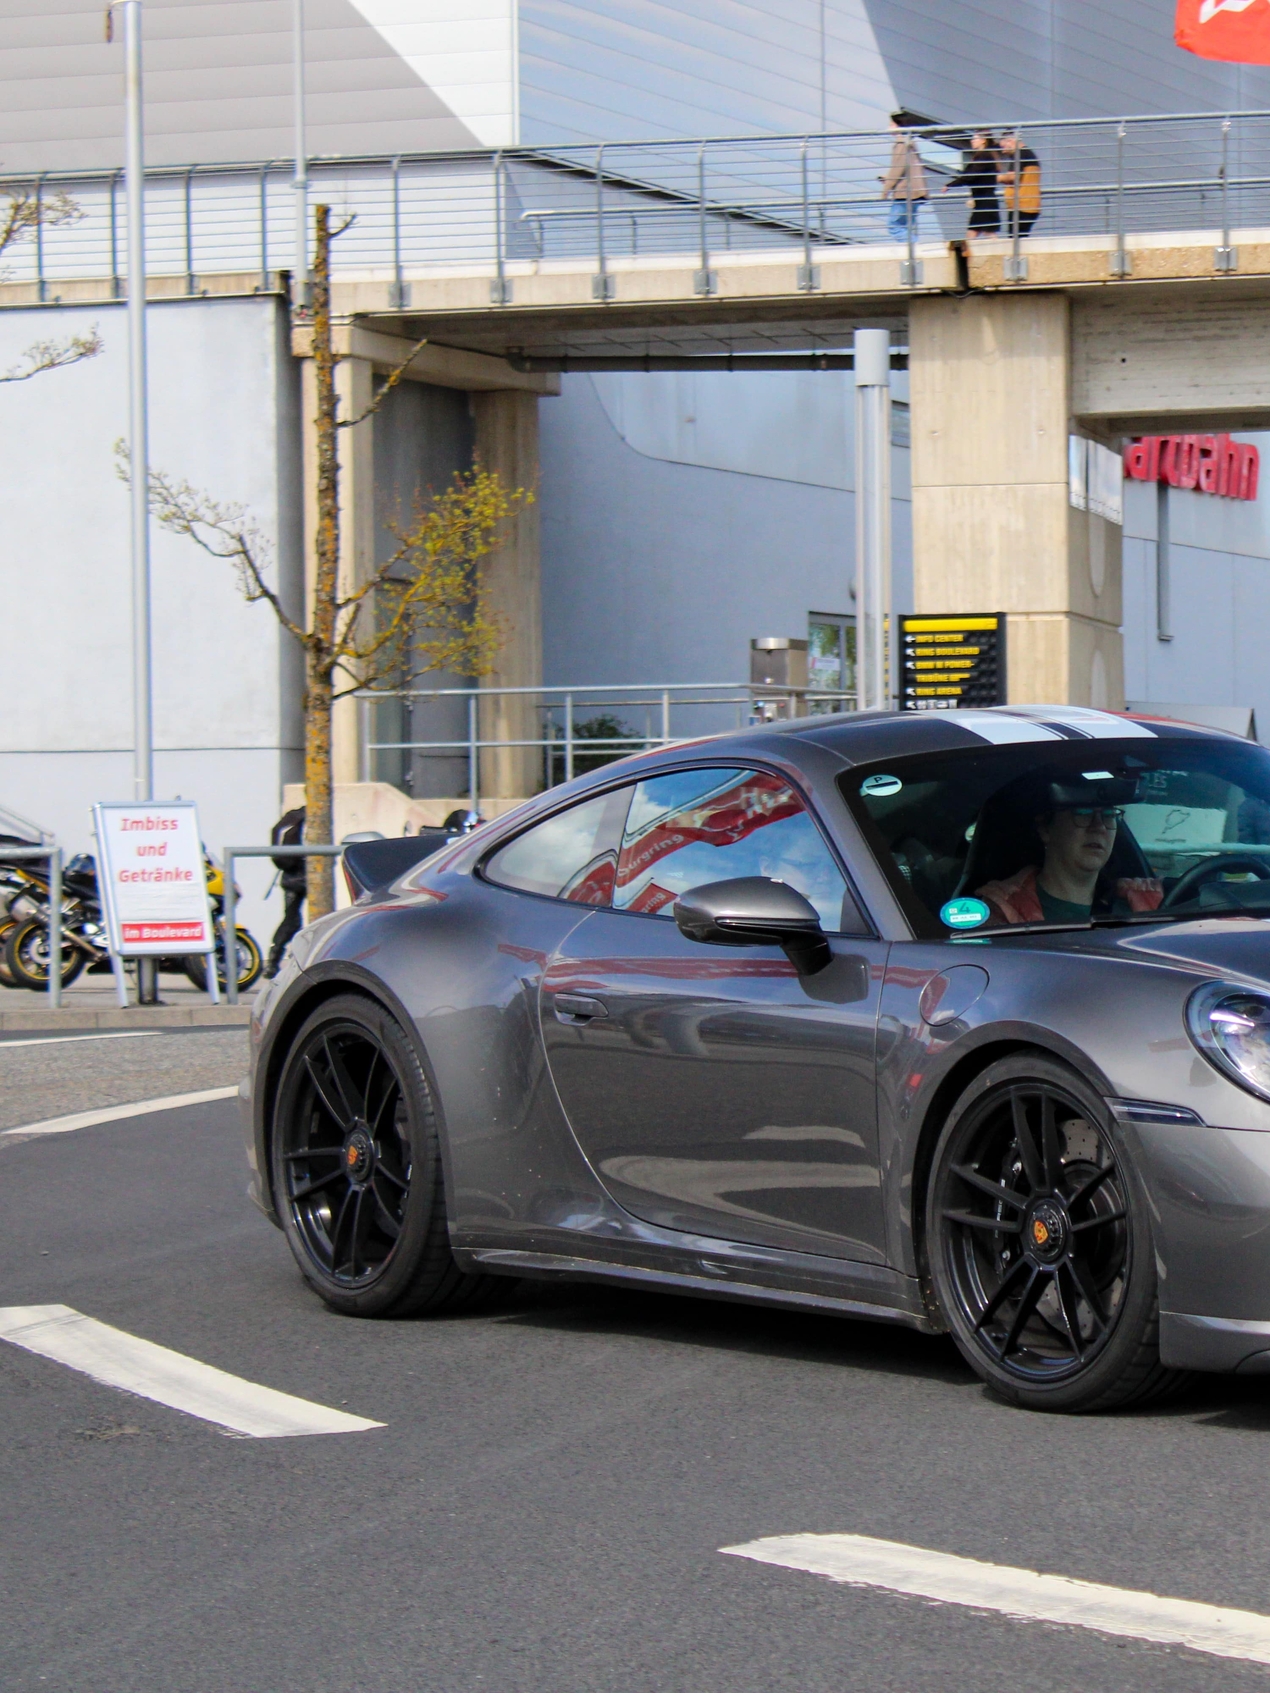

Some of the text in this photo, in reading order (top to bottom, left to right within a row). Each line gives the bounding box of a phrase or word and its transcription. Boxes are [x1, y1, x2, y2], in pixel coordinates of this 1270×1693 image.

[934, 634, 964, 643] CENTER
[120, 816, 179, 832] Imbiss
[136, 841, 168, 857] und
[119, 867, 193, 883] Getränke
[959, 902, 971, 913] 4
[125, 925, 202, 939] im Boulevard
